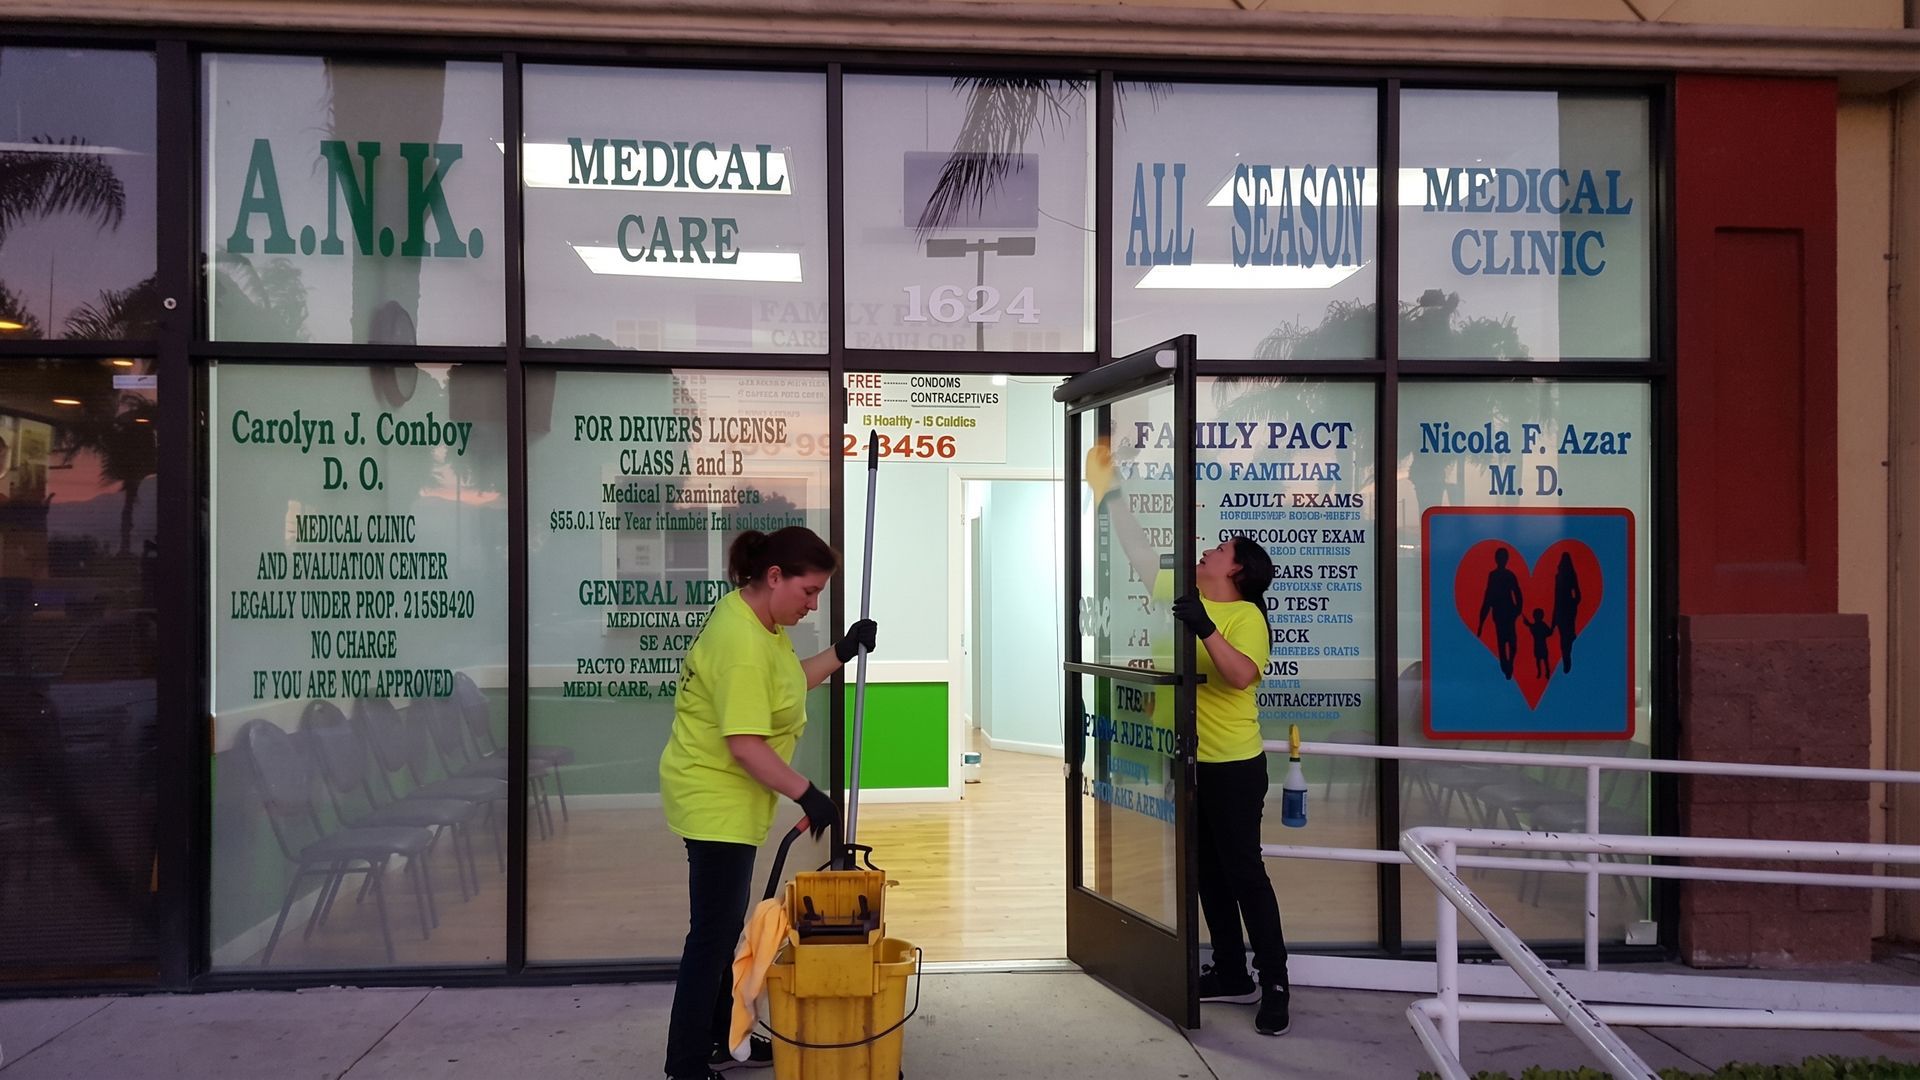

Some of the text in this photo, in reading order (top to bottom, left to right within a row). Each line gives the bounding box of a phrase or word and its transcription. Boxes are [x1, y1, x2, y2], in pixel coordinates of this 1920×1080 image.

[568, 137, 784, 192] MEDICAL
[227, 138, 484, 258] A.N.K.
[1423, 167, 1633, 216] MEDICAL
[1126, 162, 1365, 269] ALL SEASON
[617, 214, 740, 265] CARE
[1451, 228, 1606, 277] CLINIC
[903, 284, 1041, 324] 1624
[847, 374, 961, 389] FREE CONDOMS
[847, 391, 999, 407] FREE CONTRACEPTIVES
[232, 409, 473, 456] Carolyn J. Conboy
[574, 415, 787, 444] FOR DRIVERS LICENSE
[1134, 422, 1352, 449] FAILY PACT
[1420, 421, 1632, 455] Nicola F. Azar
[323, 456, 384, 490] D. O.
[620, 449, 744, 475] CLASS A and B
[1230, 462, 1342, 481] FAMILIAR
[602, 483, 760, 505] Medical Examinaters
[1489, 465, 1563, 496] M. D.
[1219, 493, 1286, 508] ADULT
[1292, 493, 1364, 508] EXAMS
[296, 515, 416, 543] MEDICAL CLINIC
[624, 511, 651, 530] Year
[1322, 529, 1366, 544] EXAM
[257, 552, 449, 580] AND EVALUATION CENTER
[1318, 565, 1358, 579] TEST
[231, 590, 475, 619] LEGALLY UNDER PROP. 215SB420
[579, 580, 733, 606] GENERAL MED
[1284, 597, 1330, 611] TEST
[607, 612, 707, 628] MEDICINA GE
[311, 630, 398, 659] NO CHARGE
[639, 634, 658, 651] SE
[577, 658, 684, 674] PACTO FAMILI
[253, 669, 454, 699] IF YOU ARE NOT APPROVED
[562, 681, 602, 697] MEDI
[607, 681, 652, 699] CARE,
